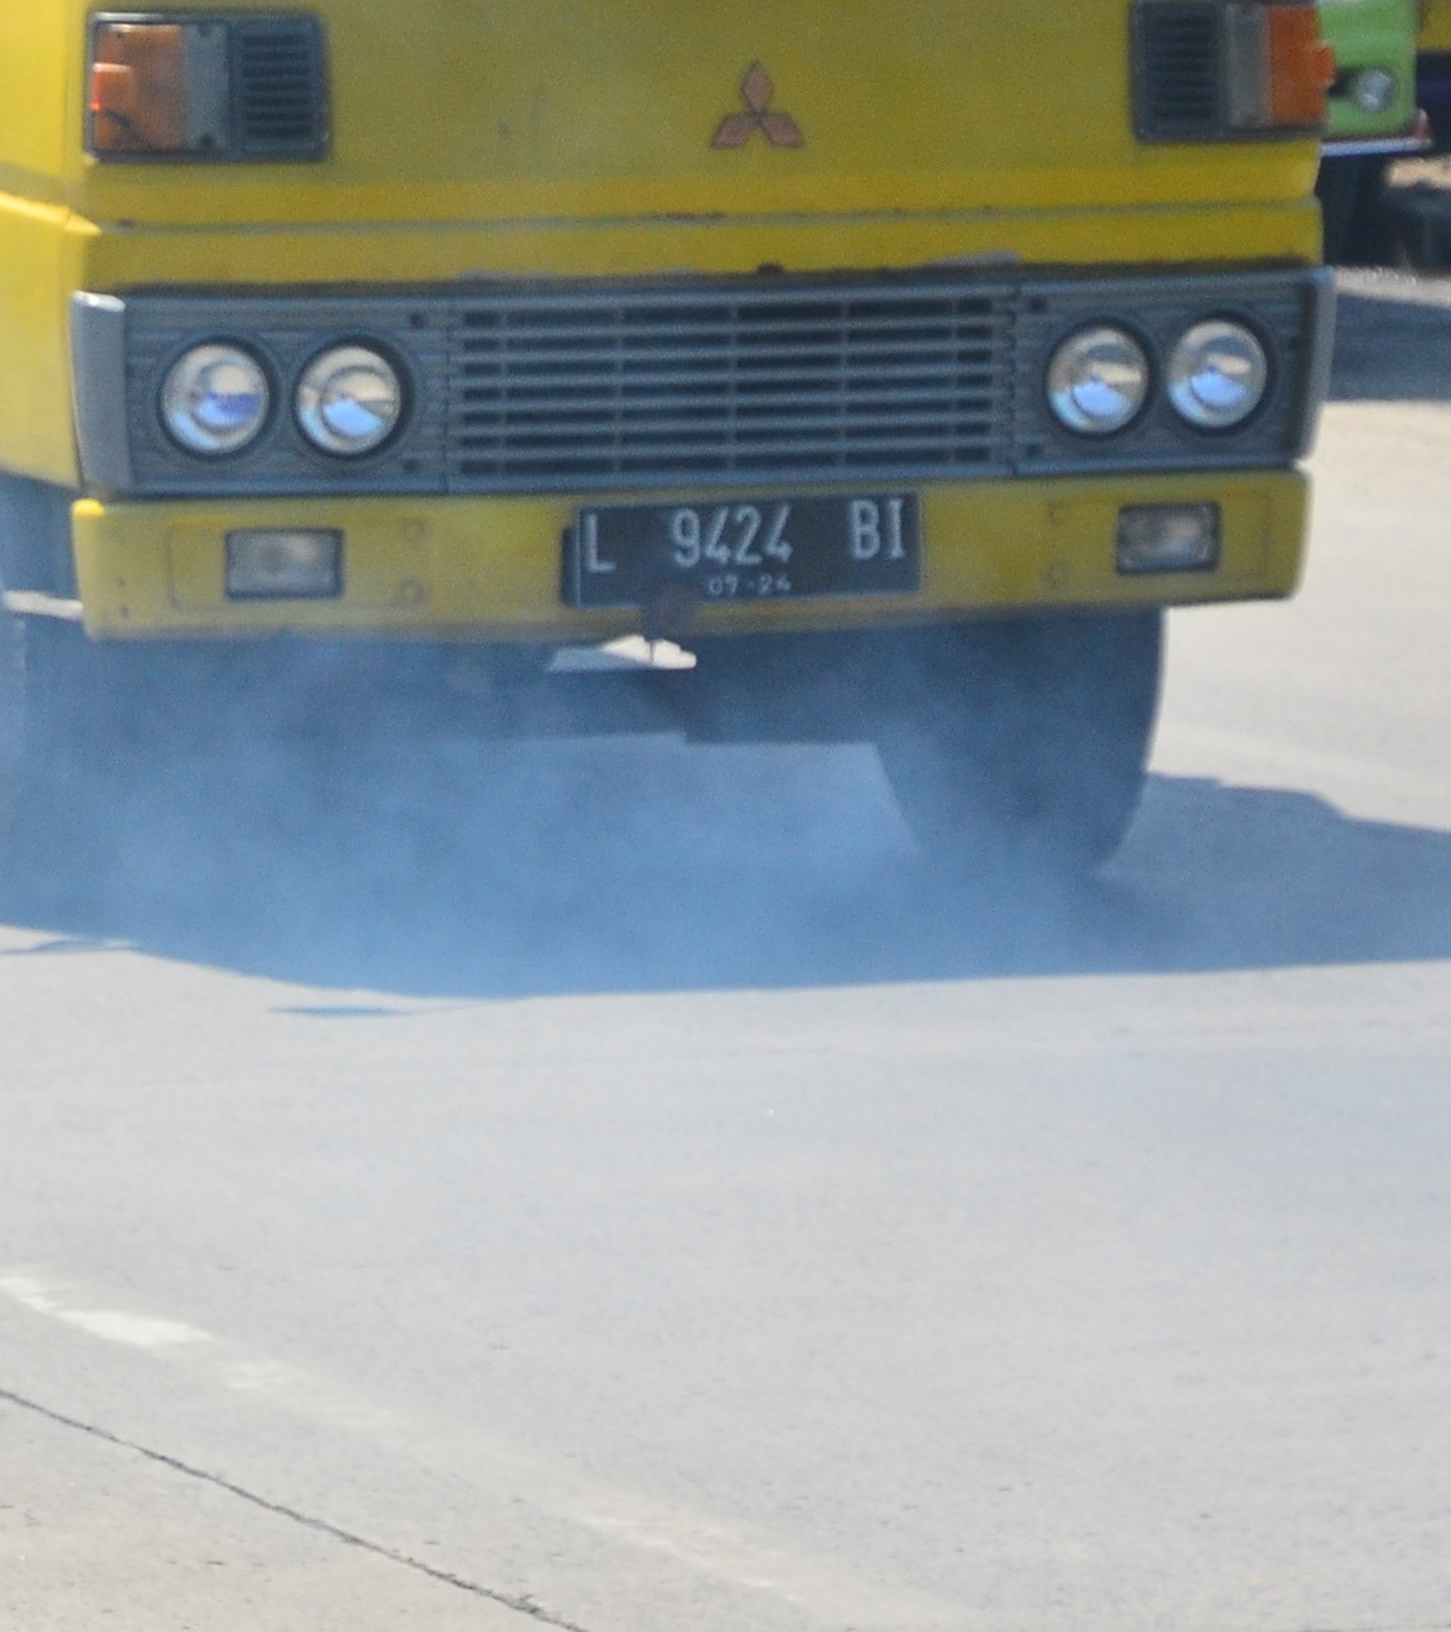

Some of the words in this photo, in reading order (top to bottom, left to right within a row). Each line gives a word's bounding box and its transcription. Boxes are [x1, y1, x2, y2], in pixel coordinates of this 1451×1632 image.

[587, 513, 617, 572] L
[671, 504, 794, 568] 9424
[852, 497, 905, 561] BI
